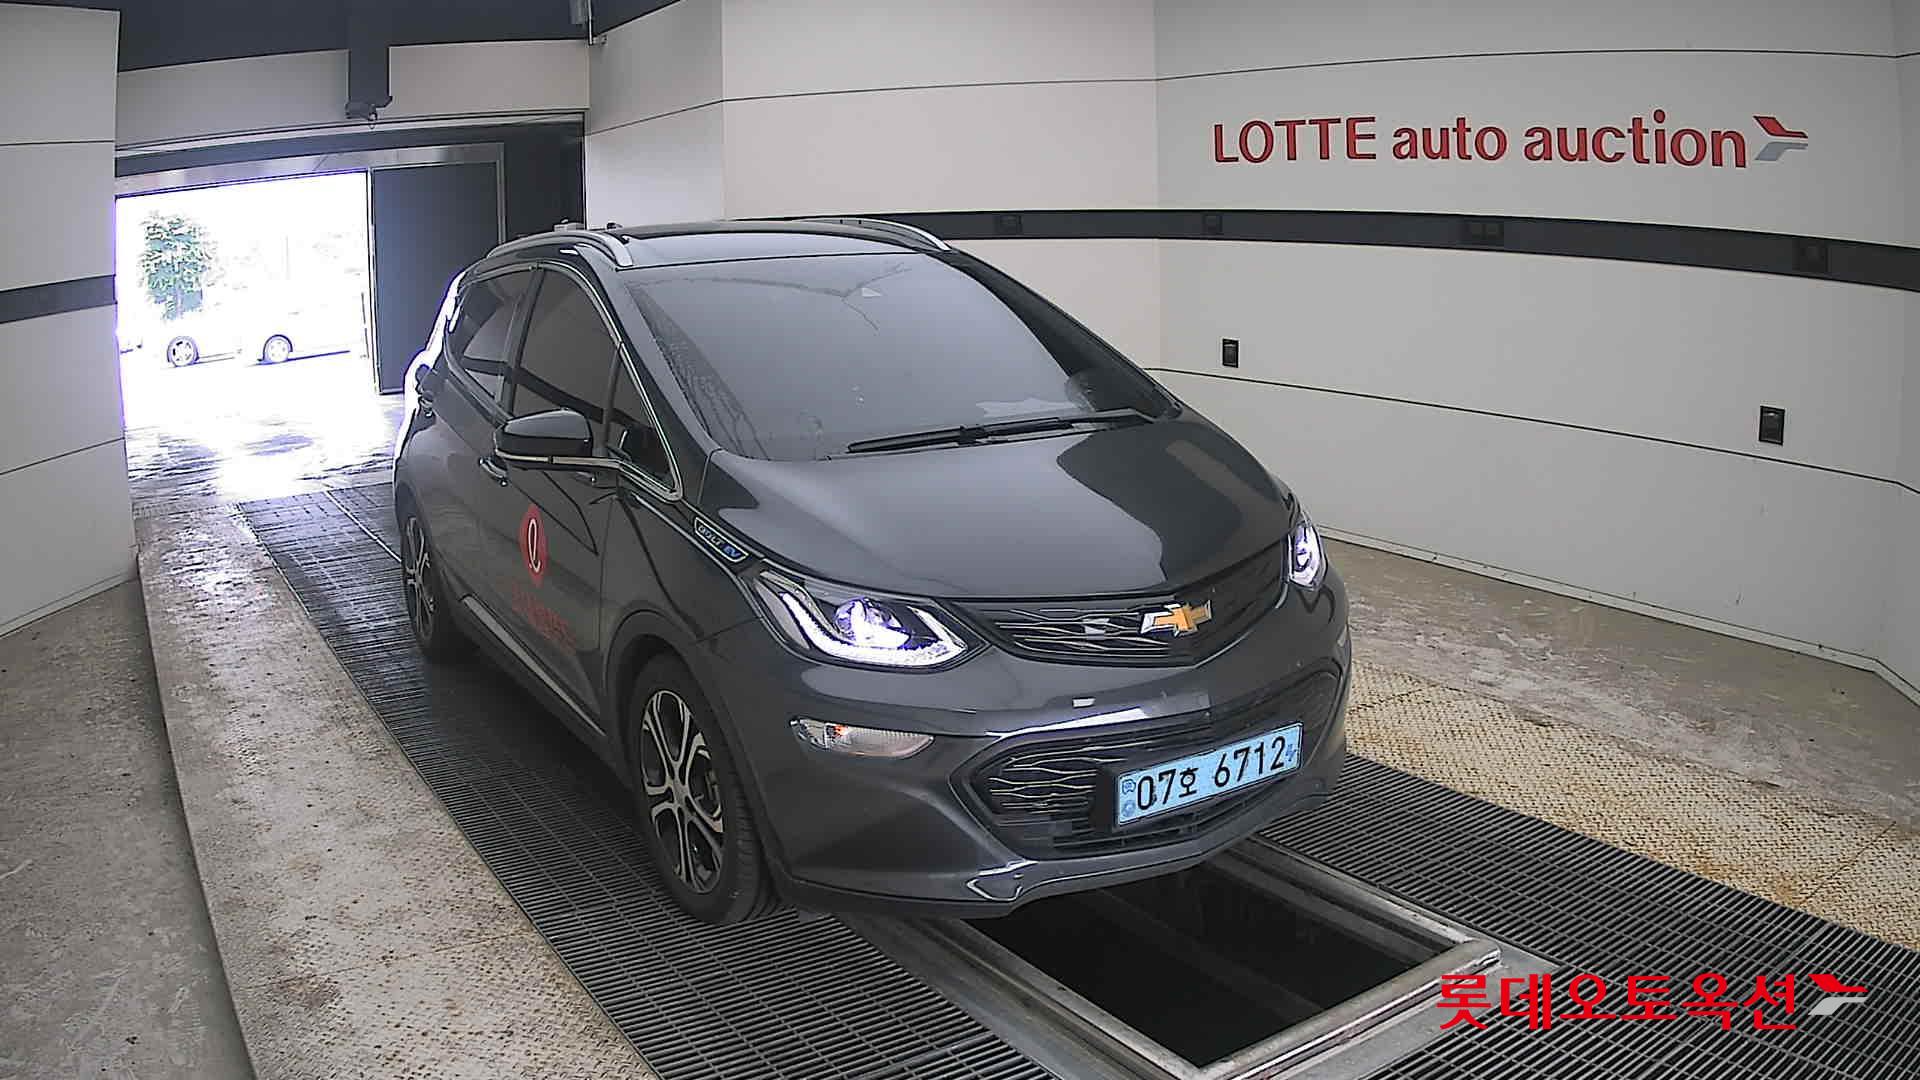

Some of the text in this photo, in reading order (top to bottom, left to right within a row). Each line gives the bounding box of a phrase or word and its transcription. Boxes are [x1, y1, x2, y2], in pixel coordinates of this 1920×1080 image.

[1213, 109, 1747, 168] LOTTE auto auction
[1137, 735, 1286, 811] 07호 6712
